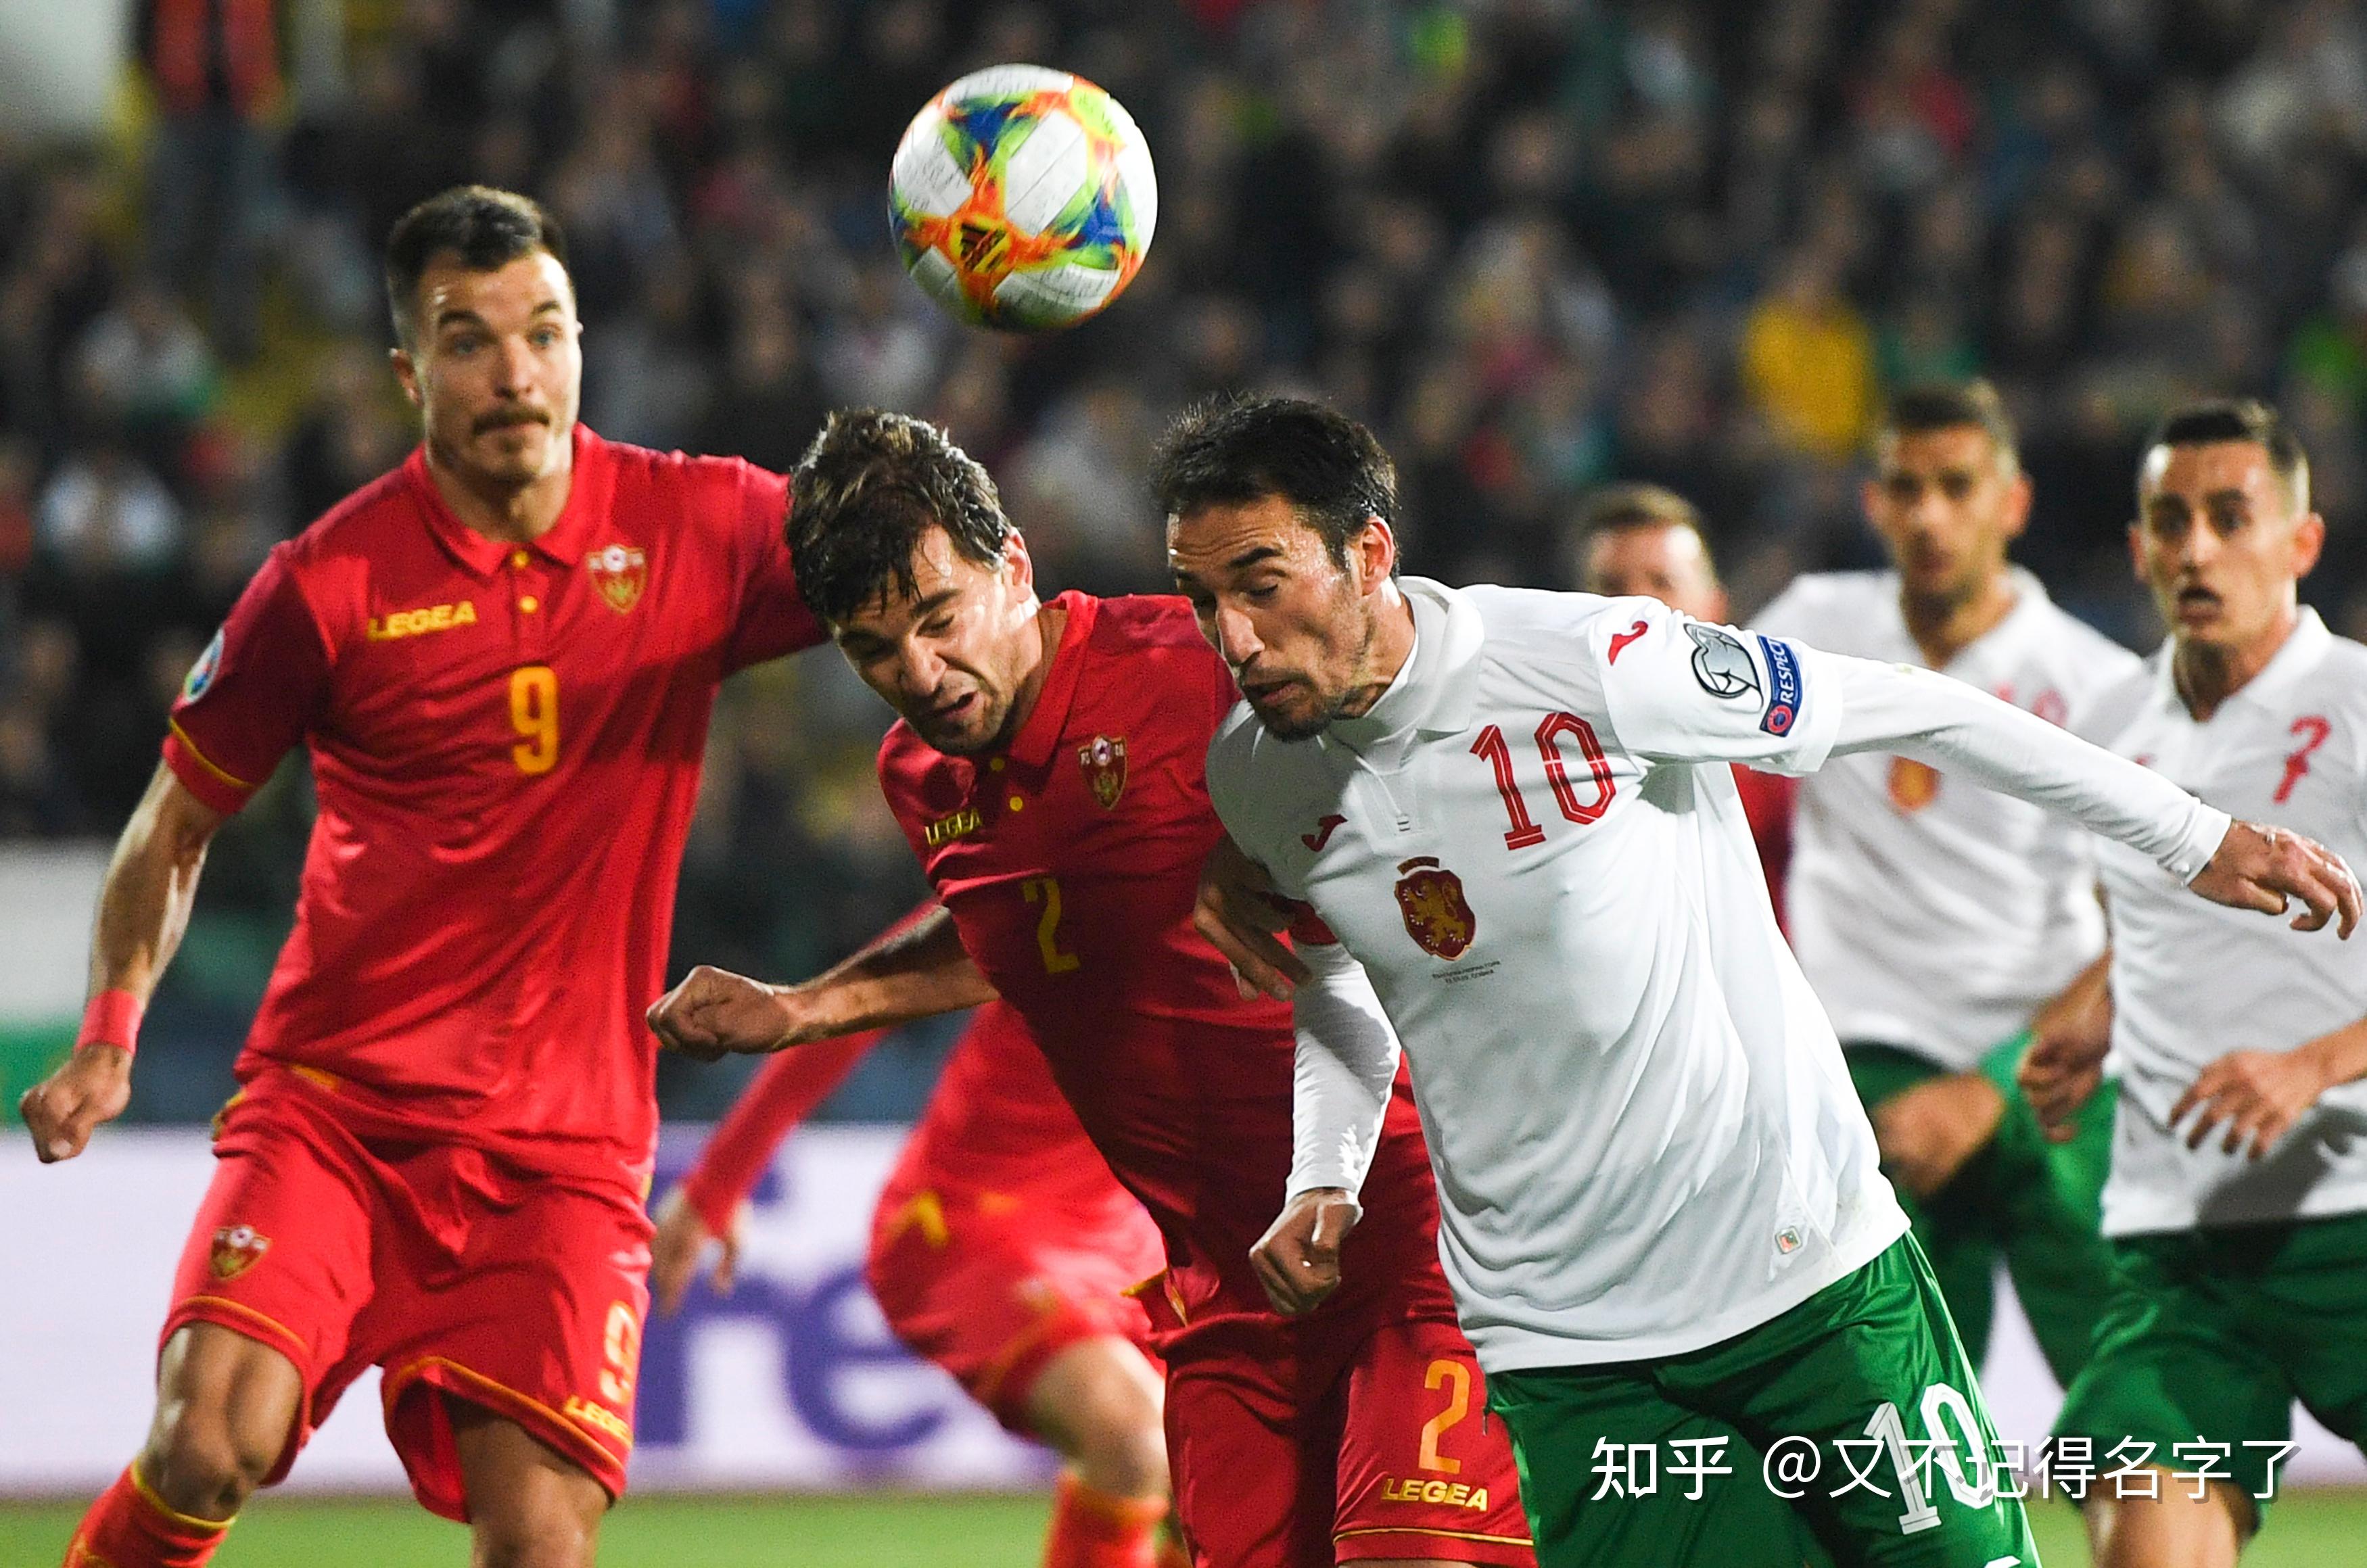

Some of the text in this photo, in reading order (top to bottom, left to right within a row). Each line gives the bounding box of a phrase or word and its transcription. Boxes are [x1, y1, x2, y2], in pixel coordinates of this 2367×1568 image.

[367, 601, 477, 642] LEGEA
[511, 666, 559, 776] 9
[2273, 715, 2331, 805] 7
[1470, 711, 1616, 851] 10
[1022, 878, 1080, 974] 2
[599, 1300, 638, 1406] 9
[1419, 1359, 1471, 1474] 2
[1863, 1382, 1994, 1535] 10
[1381, 1479, 1488, 1511] LEGEA
